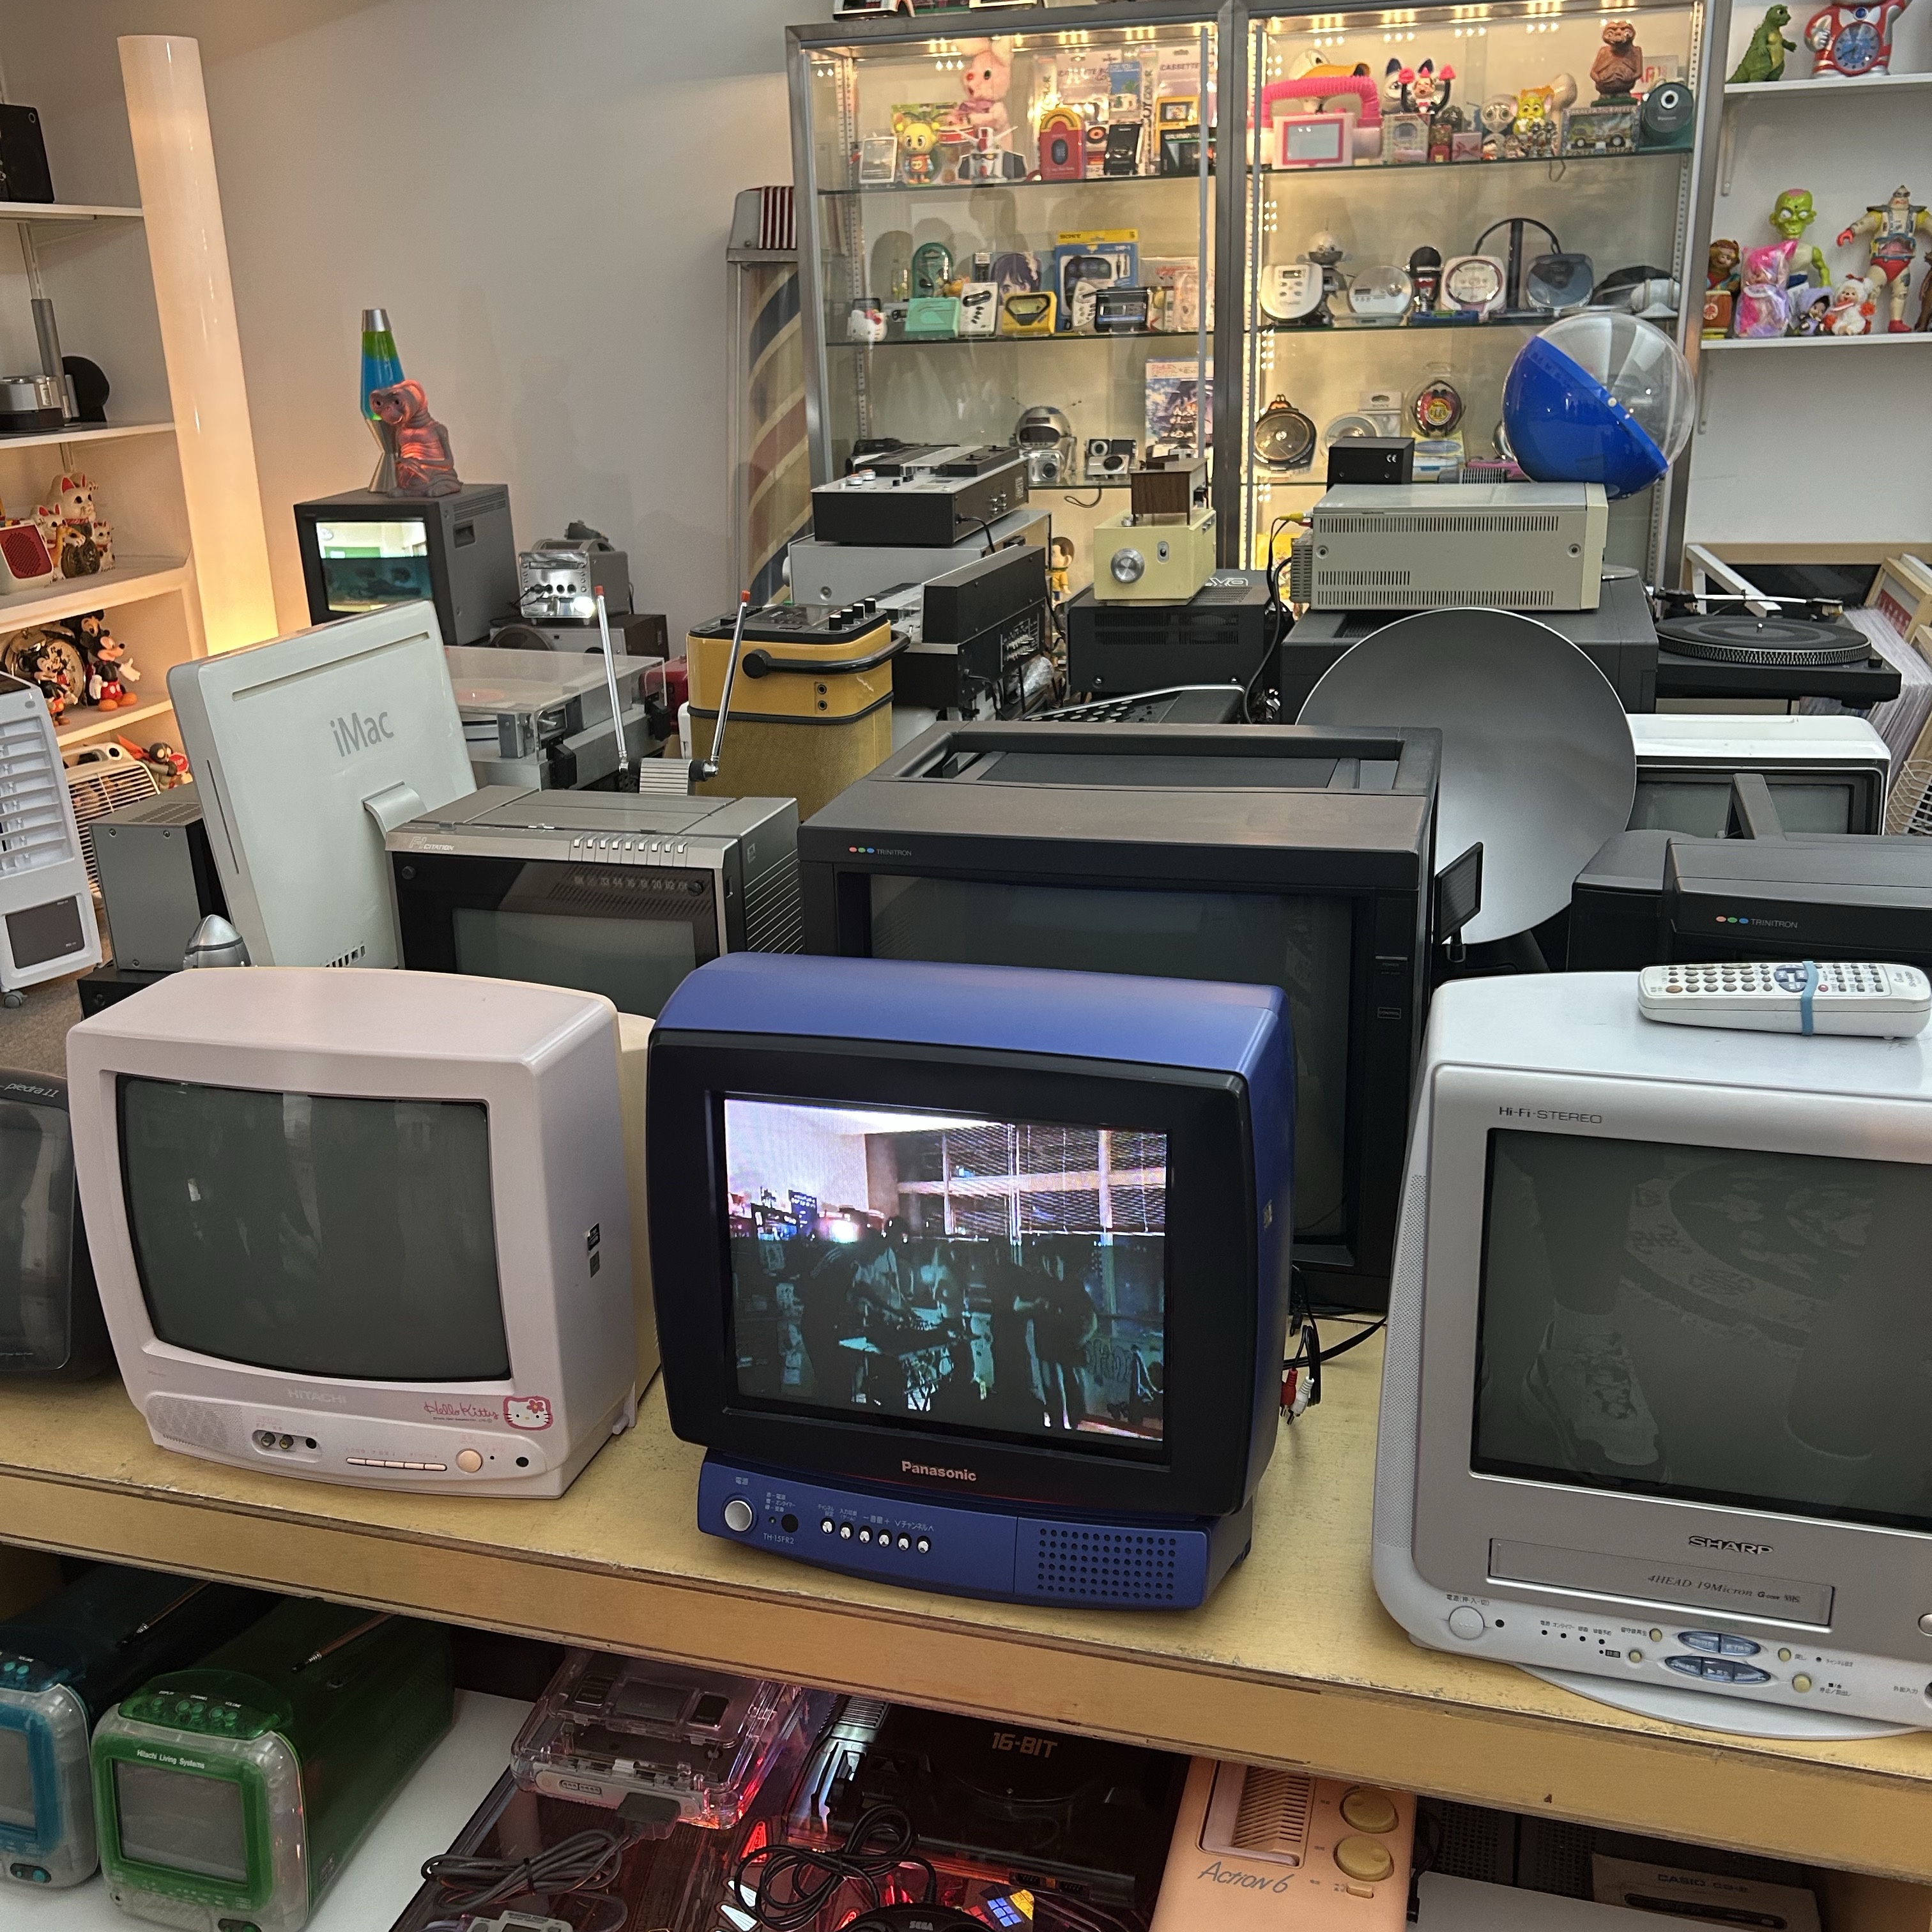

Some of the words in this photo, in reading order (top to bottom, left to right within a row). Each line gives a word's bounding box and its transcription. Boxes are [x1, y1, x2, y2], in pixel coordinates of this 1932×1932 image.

[330, 711, 395, 757] iMac
[877, 848, 912, 857] TRINITRON
[1751, 918, 1798, 928] TRINITRON
[4, 1083, 45, 1094] piedra
[288, 1388, 347, 1404] HITACHI
[424, 1400, 460, 1416] Hello
[459, 1402, 500, 1420] Kitty
[901, 1460, 977, 1481] Panasonic
[1689, 1535, 1774, 1555] SHARP
[1648, 1574, 1692, 1588] 4HEAD
[1697, 1581, 1753, 1597] 19Micron
[992, 1732, 1058, 1758] 16-BIT
[137, 1749, 158, 1761] Hitachi
[159, 1753, 178, 1765] Living
[179, 1757, 206, 1770] Systems
[1657, 1873, 1706, 1887] CASIO
[909, 1920, 933, 1931] SEGA
